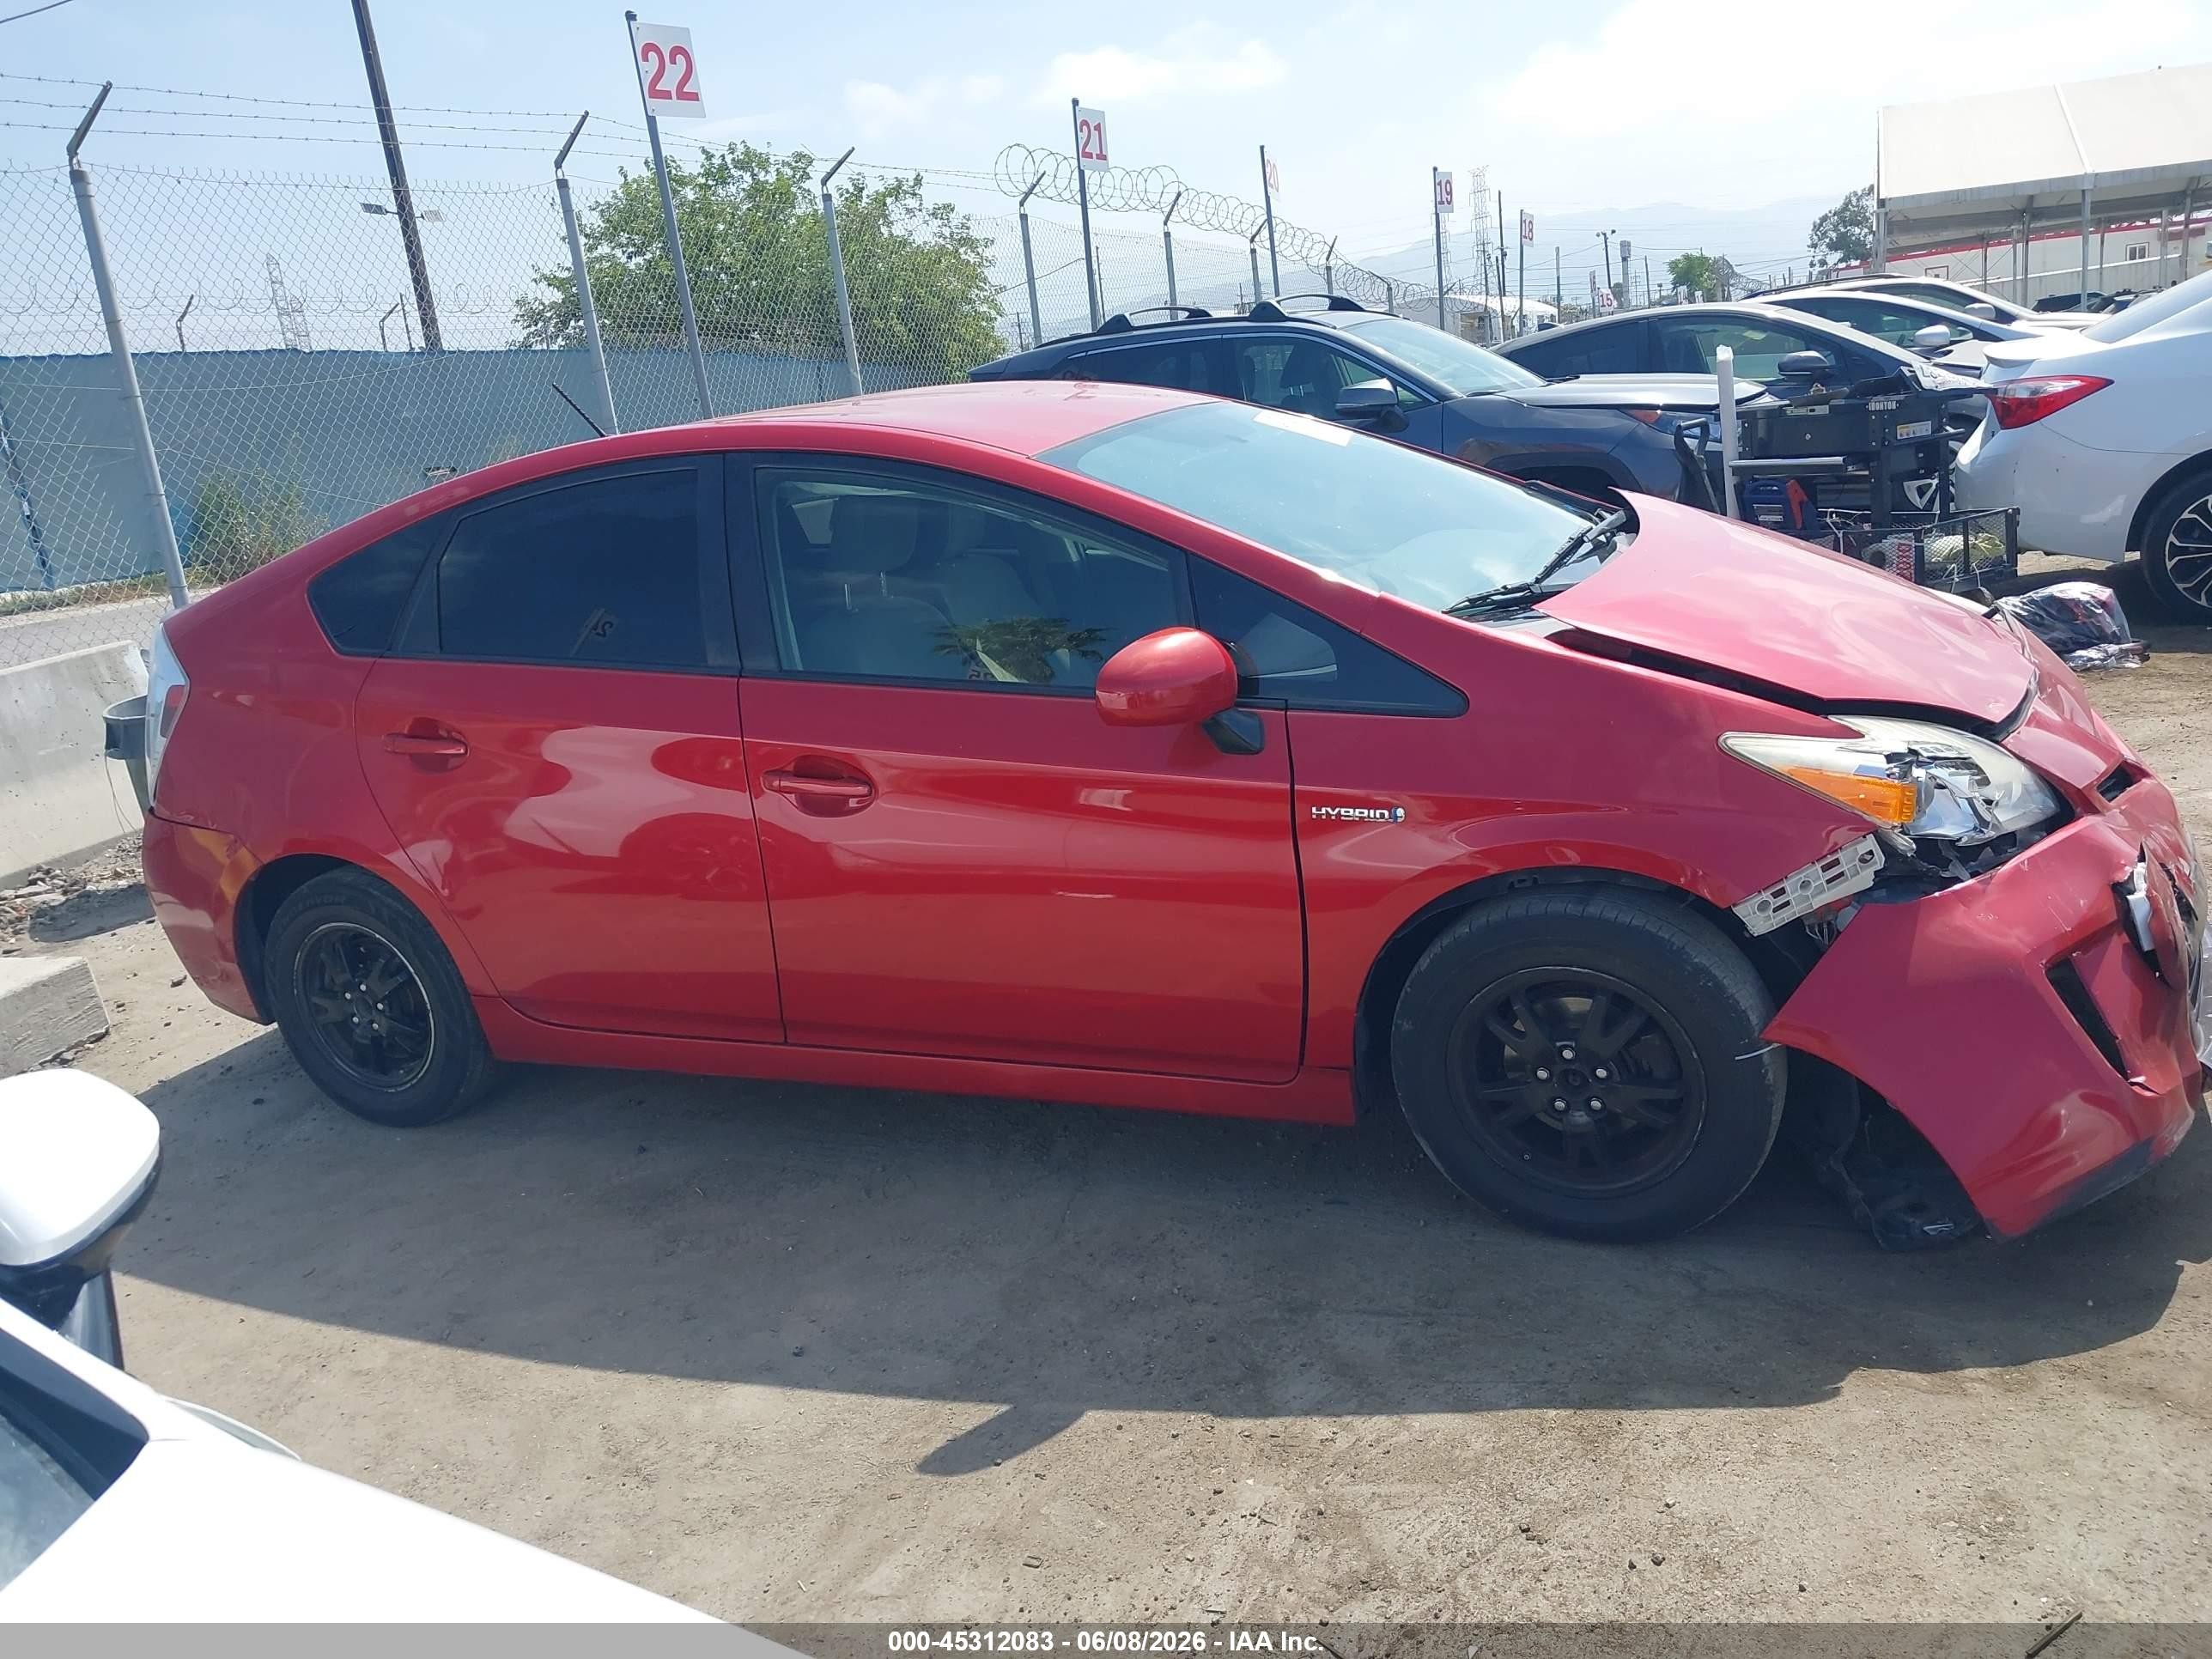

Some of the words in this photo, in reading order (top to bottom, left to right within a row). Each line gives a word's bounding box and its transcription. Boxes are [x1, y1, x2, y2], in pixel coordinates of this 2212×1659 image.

[641, 42, 701, 101] 22
[1079, 119, 1107, 161] 21
[1266, 158, 1279, 193] 20
[1437, 179, 1453, 205] 19
[1522, 218, 1534, 241] 18
[1600, 294, 1613, 307] 15
[1311, 806, 1392, 822] HYBRID
